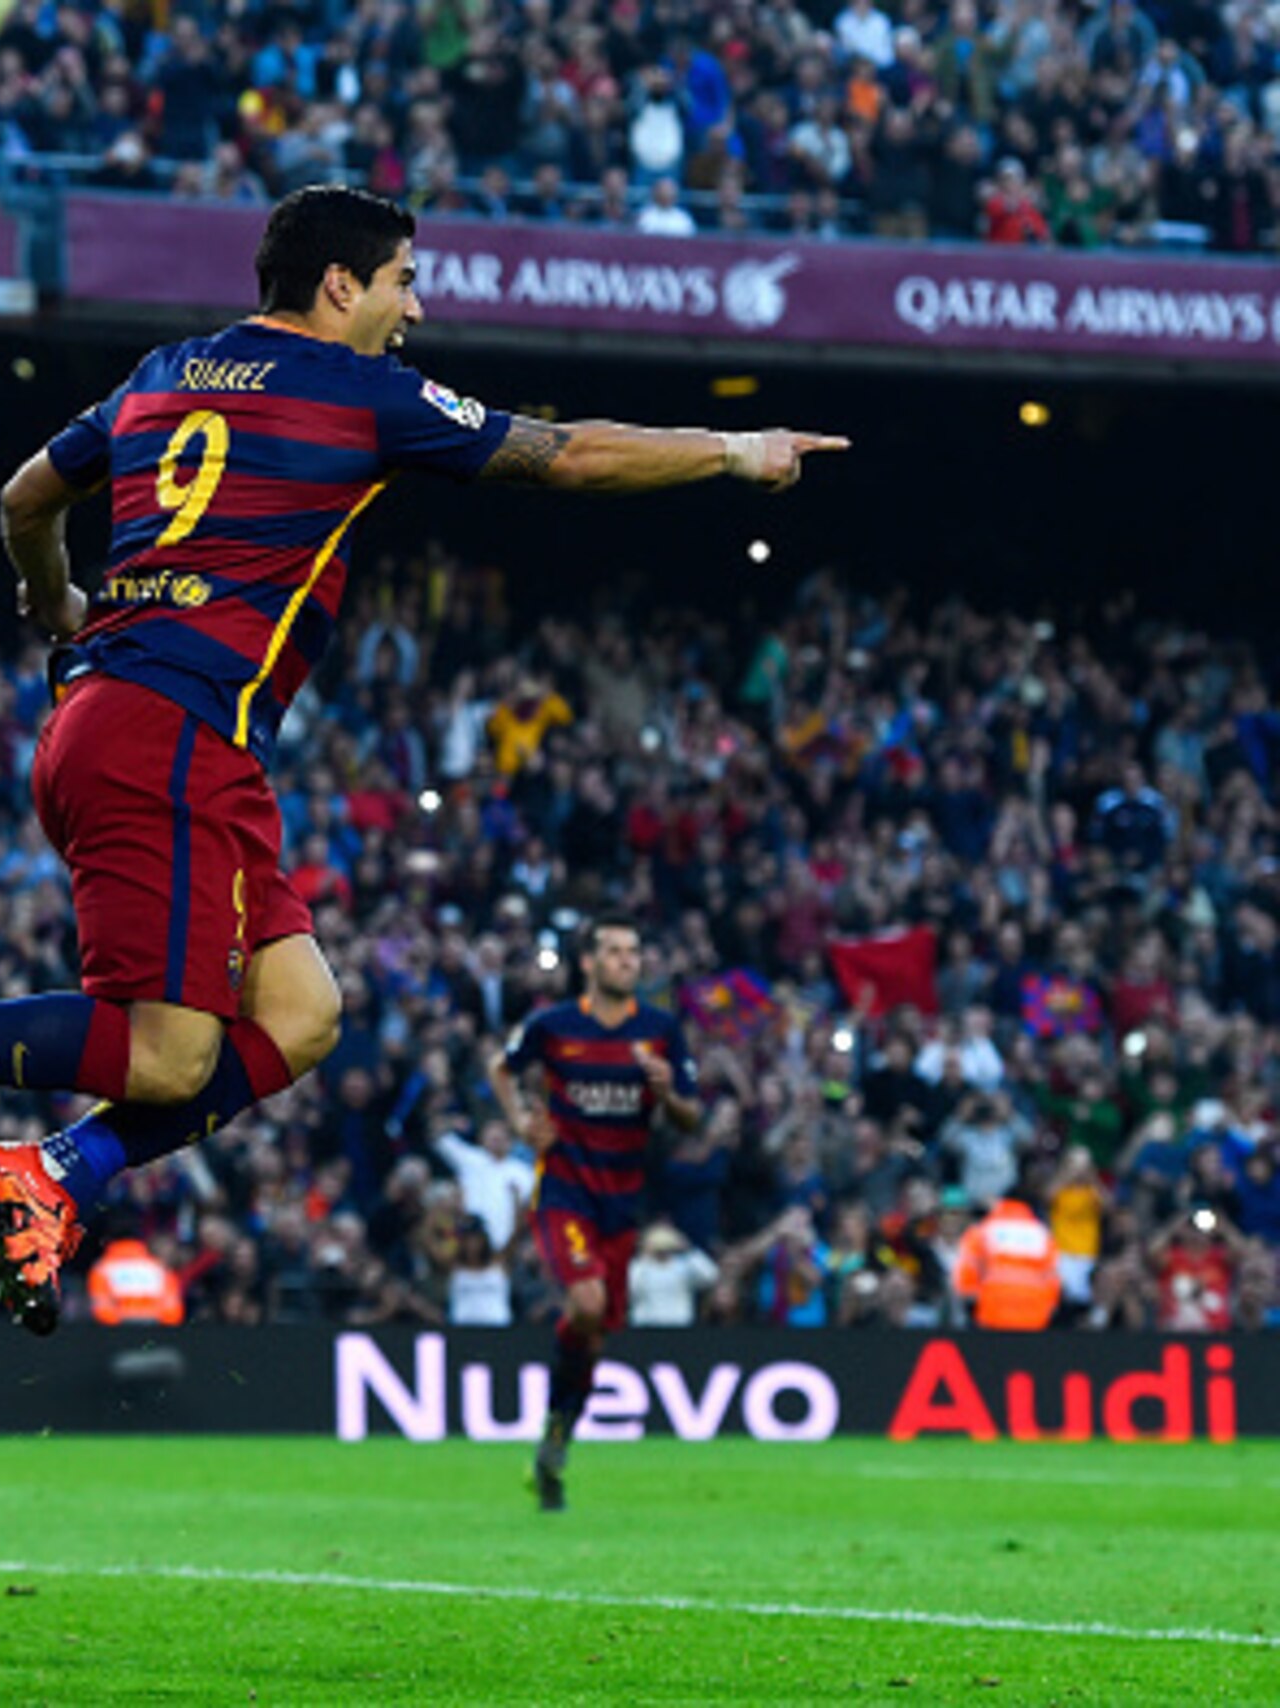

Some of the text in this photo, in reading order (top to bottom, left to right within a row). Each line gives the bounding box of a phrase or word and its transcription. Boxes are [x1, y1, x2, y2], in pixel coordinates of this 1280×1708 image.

[413, 250, 717, 317] TAR AIRWAYS
[894, 275, 1266, 343] QATAR AIRWAYS
[155, 409, 230, 547] 9
[335, 1331, 1236, 1444] Nuevo Audi
